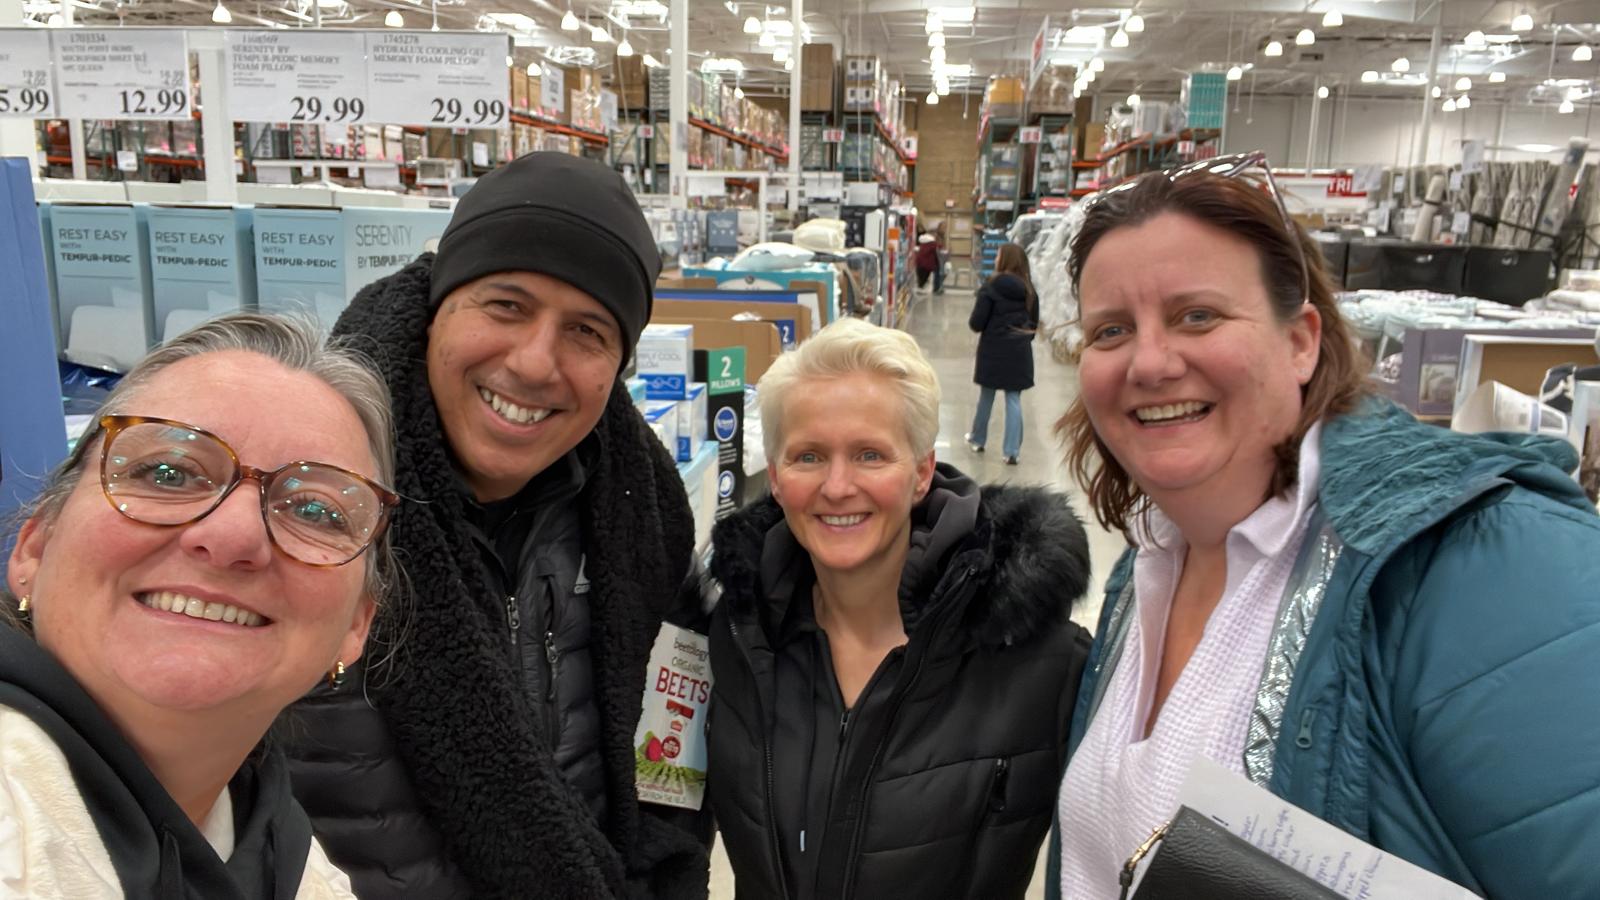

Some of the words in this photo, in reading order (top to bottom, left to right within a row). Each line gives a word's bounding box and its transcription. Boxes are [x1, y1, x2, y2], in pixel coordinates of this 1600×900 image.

[231, 45, 275, 54] SERENITY
[232, 54, 298, 63] TEMPUR-PEDIC
[301, 55, 340, 64] MEMORY
[373, 54, 414, 64] MEMORY
[416, 55, 443, 64] FOAM
[444, 56, 480, 65] PILLOW
[232, 63, 259, 71] FOAM
[261, 64, 295, 72] PILLOW
[119, 90, 187, 114] 12.99
[290, 96, 365, 122] 29.99
[431, 97, 505, 125] 29.99
[59, 229, 90, 241] REST
[94, 230, 127, 242] EASY
[155, 231, 186, 244] REST
[190, 232, 225, 246] EASY
[261, 231, 294, 245] REST
[299, 232, 335, 246] EASY
[355, 224, 413, 246] SERENITY
[262, 247, 285, 255] WITH
[61, 252, 132, 264] TEMPUR-PEDIC
[156, 255, 229, 268] TEMPUR-PEDIC
[263, 256, 337, 268] TEMPUR-PEDIC
[357, 255, 368, 268] BY
[721, 356, 732, 378] 2
[711, 378, 741, 389] PILLOWS
[672, 656, 705, 676] ORGANIC
[656, 666, 710, 705] BEETS
